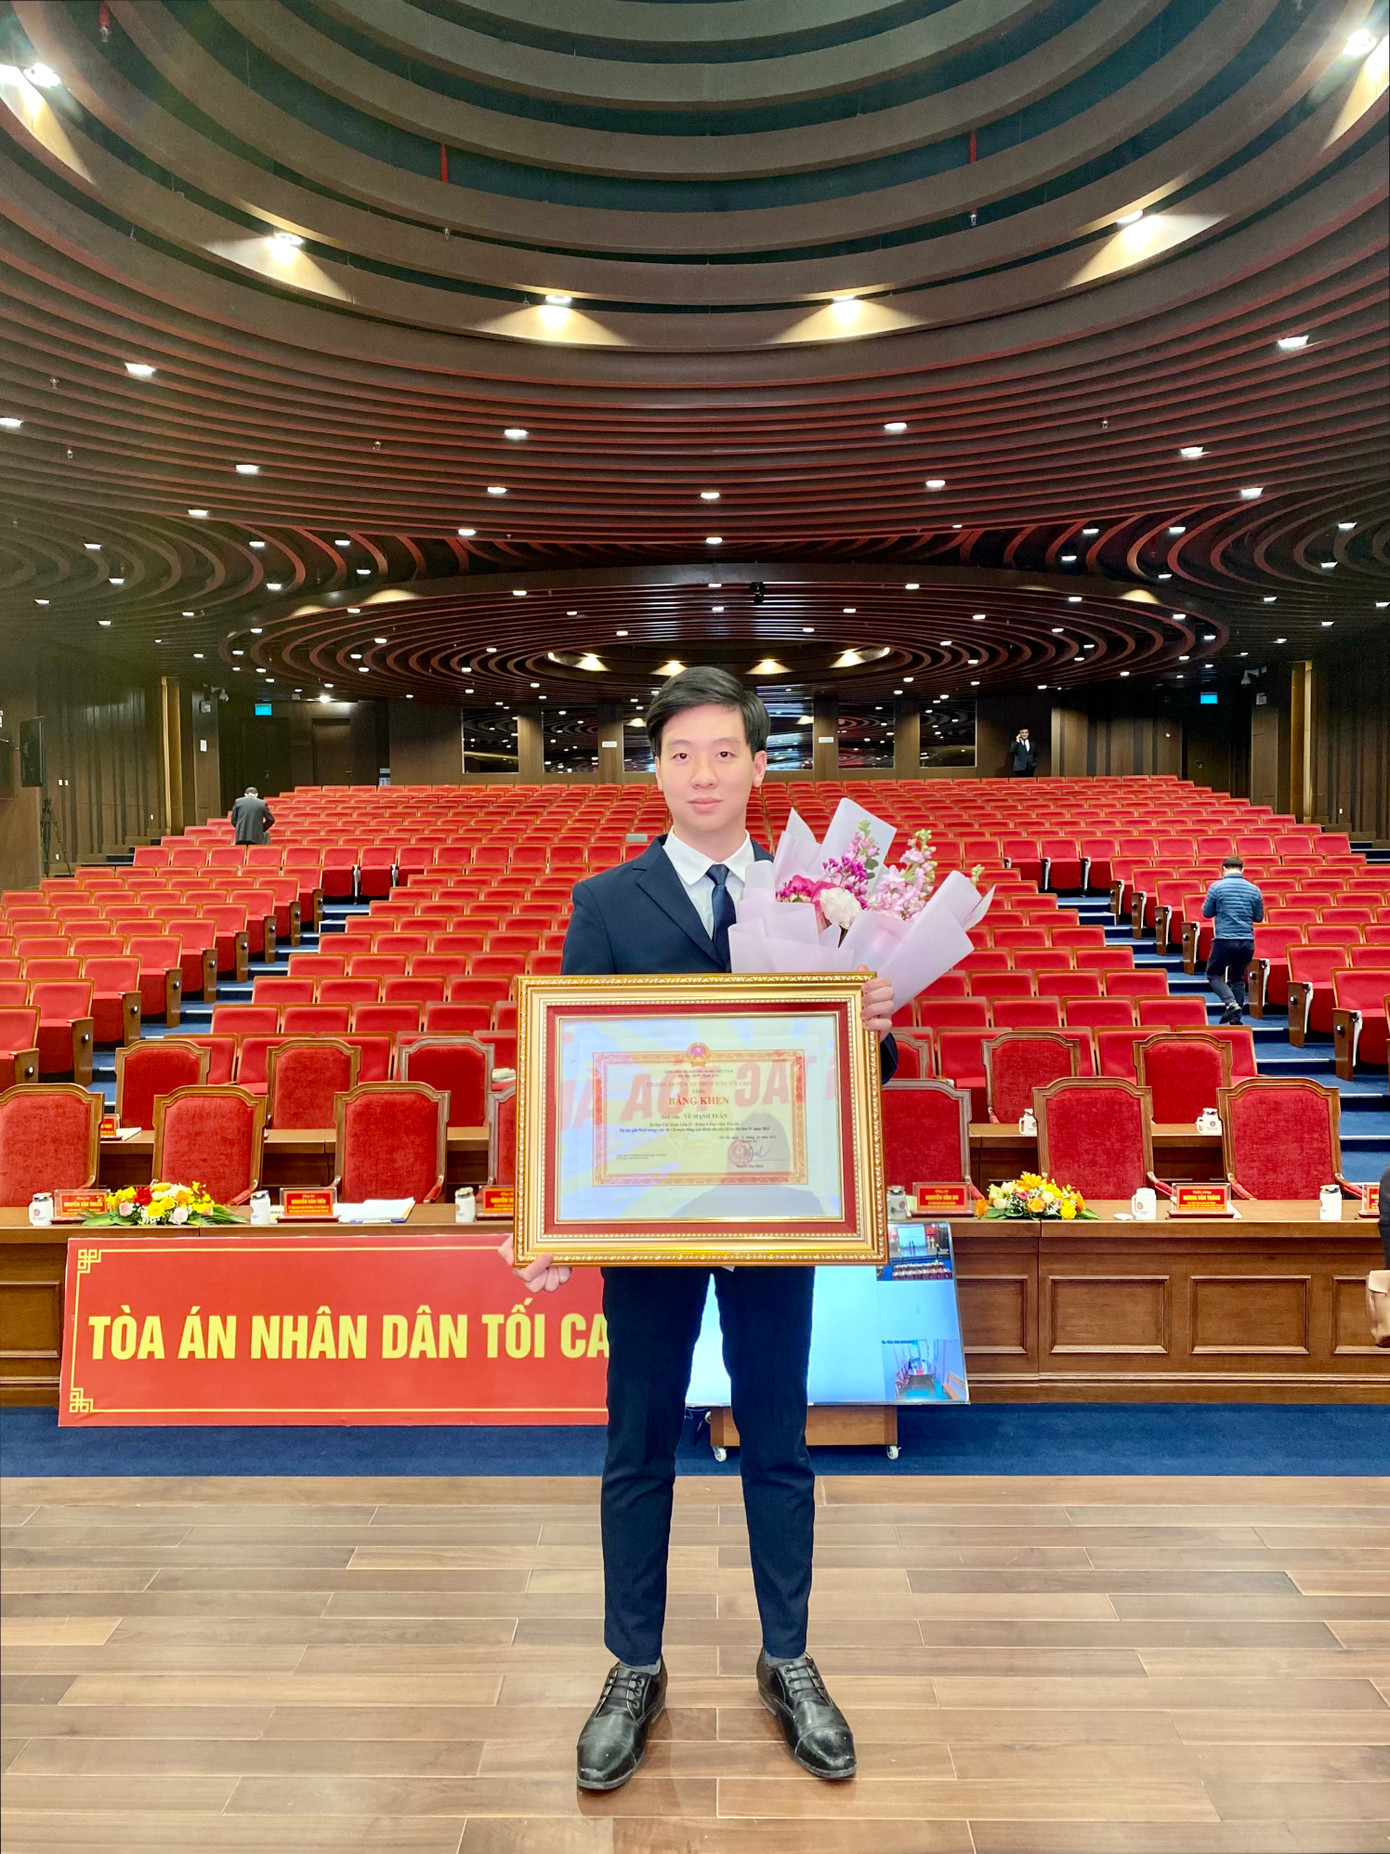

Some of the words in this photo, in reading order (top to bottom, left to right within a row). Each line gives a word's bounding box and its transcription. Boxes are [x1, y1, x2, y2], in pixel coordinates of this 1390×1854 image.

[700, 1096, 729, 1105] KHEN
[88, 1305, 165, 1360] TÒA
[178, 1306, 236, 1359] ÁN
[251, 1306, 367, 1359] NHÂN
[382, 1305, 467, 1359] DÂN
[482, 1298, 552, 1359] TỐI
[561, 1313, 609, 1359] CA
